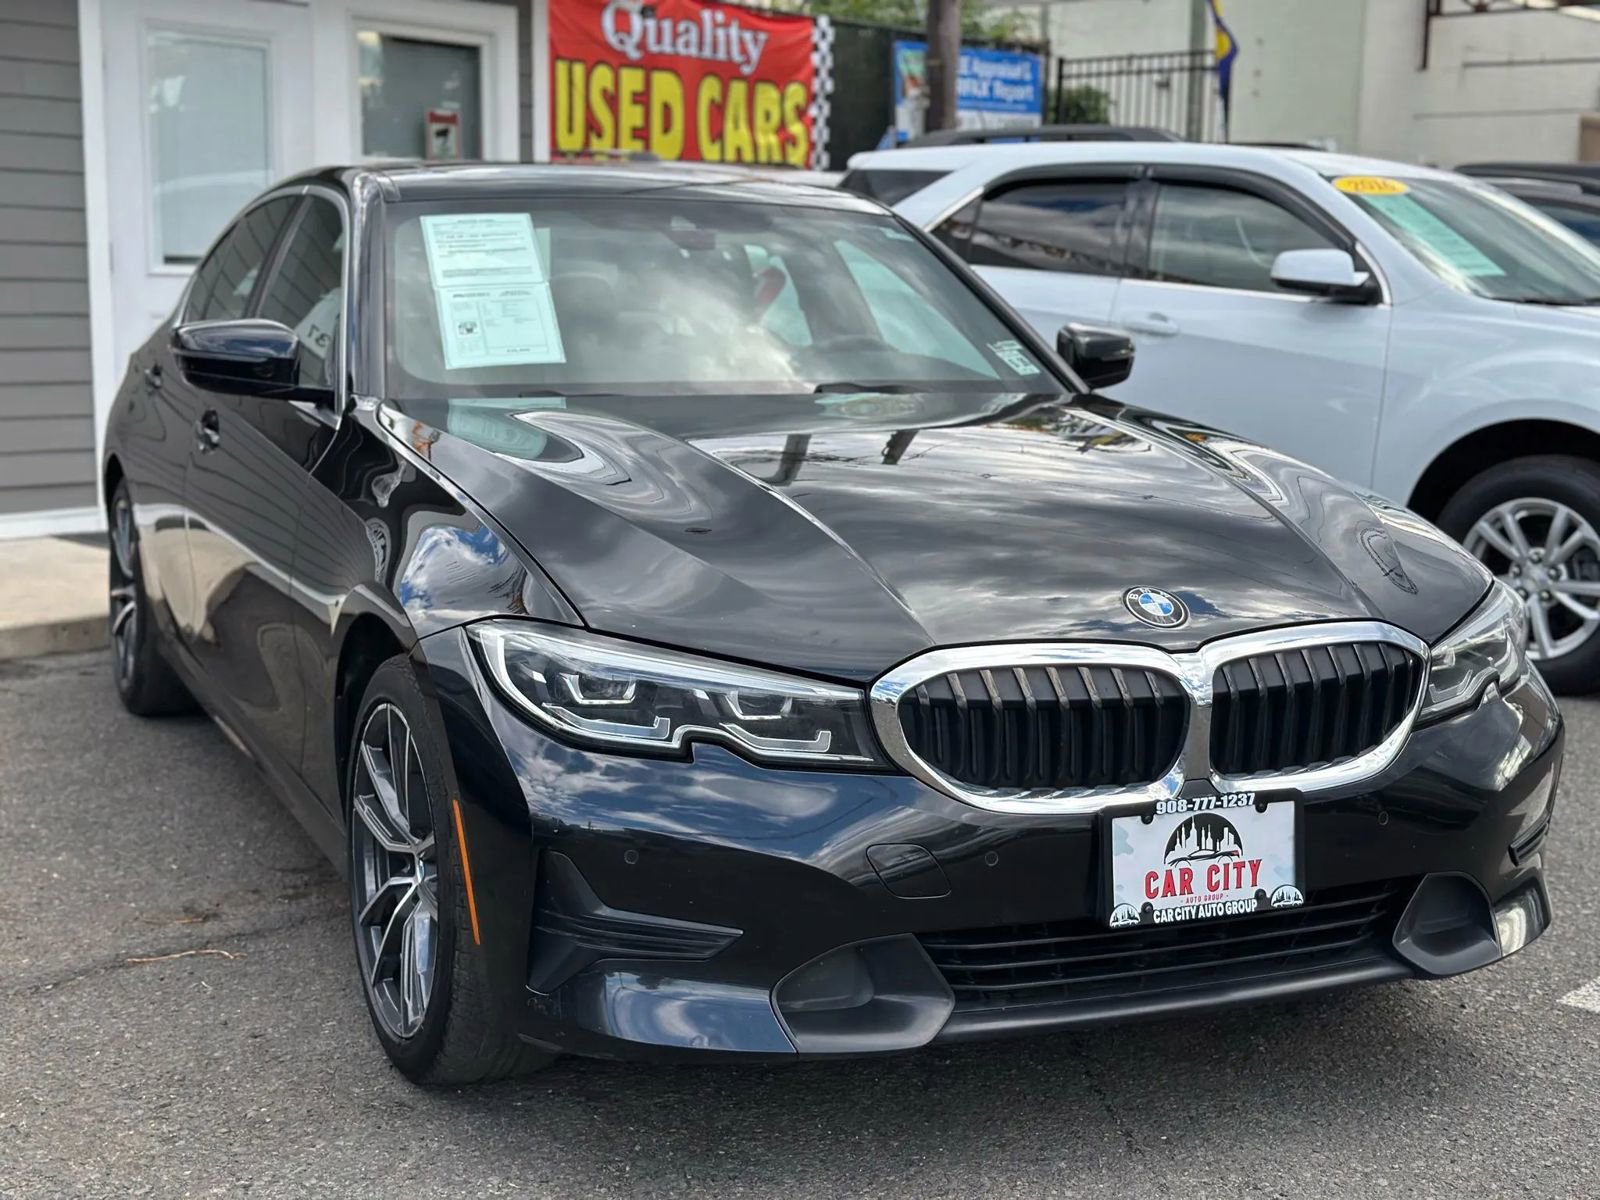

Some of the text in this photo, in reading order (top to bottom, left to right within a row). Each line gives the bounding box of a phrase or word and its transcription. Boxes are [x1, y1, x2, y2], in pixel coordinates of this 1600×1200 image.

[602, 0, 768, 75] Quality
[555, 59, 809, 167] USED CARS
[1155, 793, 1255, 815] 908-777-1237
[1145, 859, 1262, 899] CAR CITY
[1153, 899, 1258, 923] CAR CITY AUTO GROUP
[1186, 893, 1224, 904] AUTO GROUP
